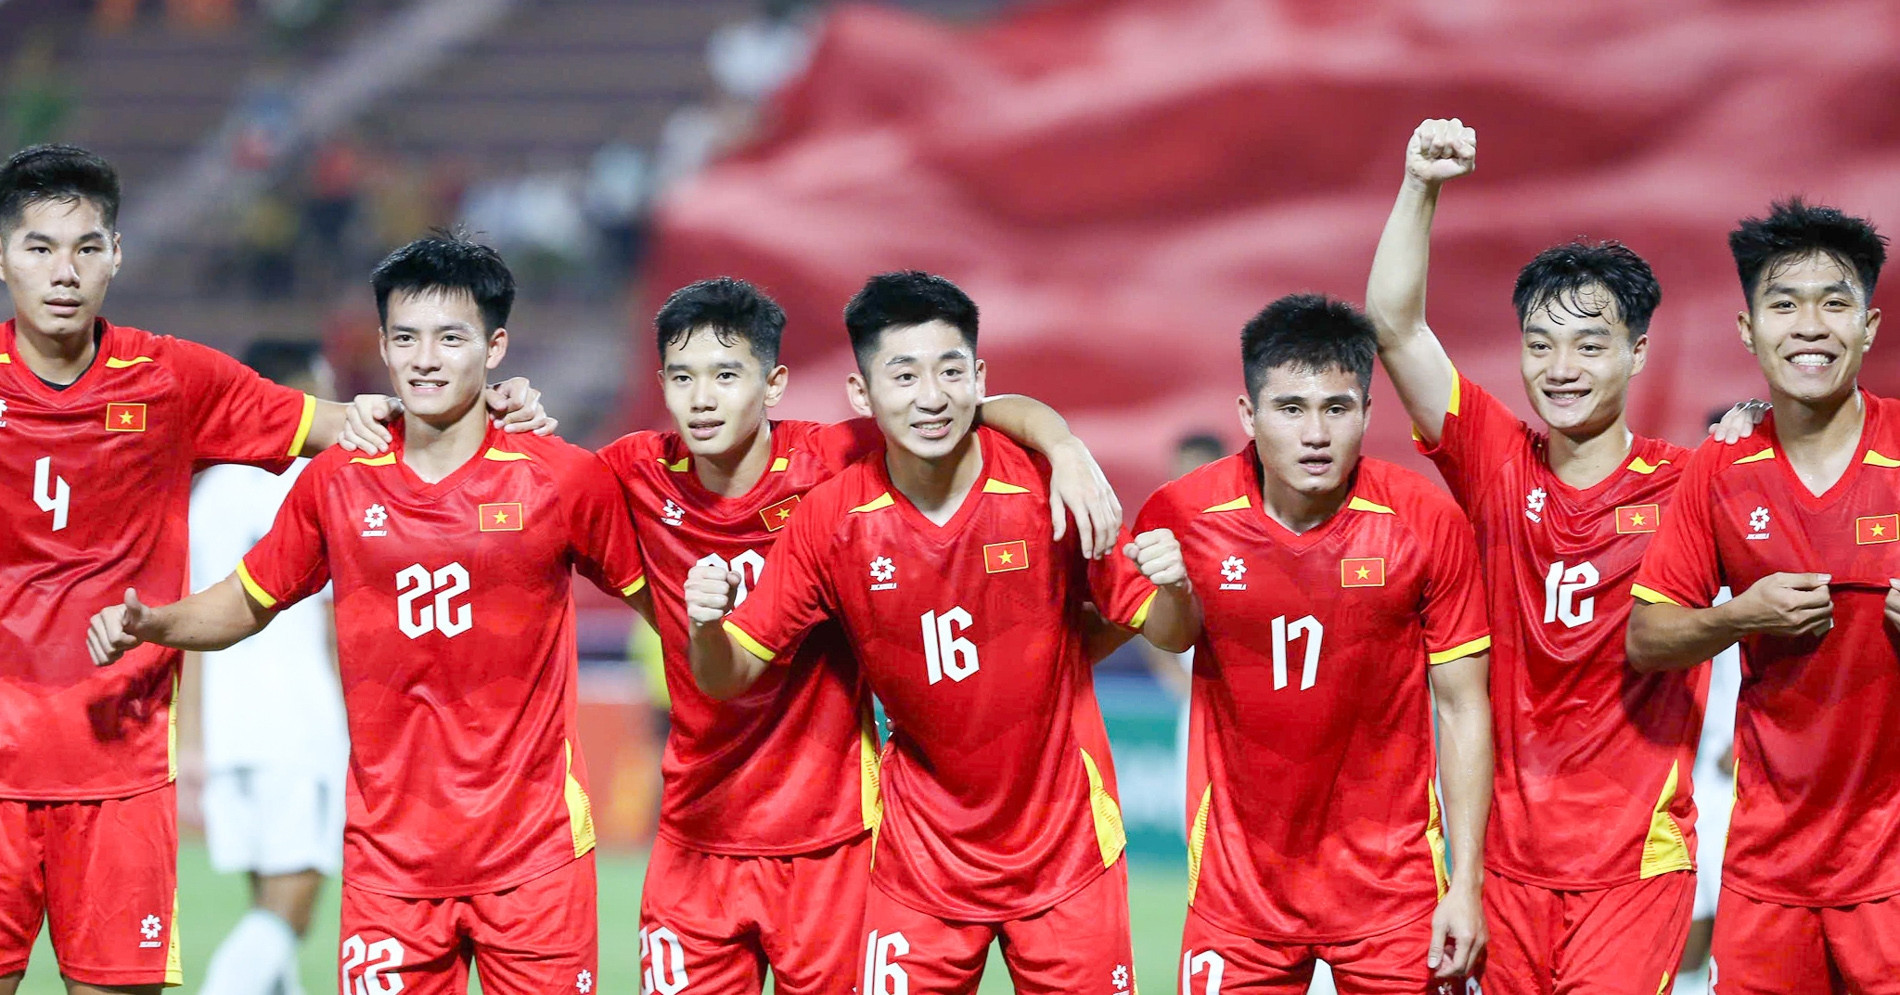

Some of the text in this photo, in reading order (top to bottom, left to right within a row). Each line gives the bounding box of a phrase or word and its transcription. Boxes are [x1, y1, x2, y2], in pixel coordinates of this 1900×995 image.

[33, 456, 71, 531] 4
[395, 561, 472, 640] 22
[696, 548, 765, 617] 0
[1543, 561, 1600, 629] 12
[920, 606, 980, 686] 16
[1271, 615, 1324, 691] 17
[342, 933, 405, 995] 22
[863, 928, 910, 995] 16
[1182, 948, 1225, 995] 17
